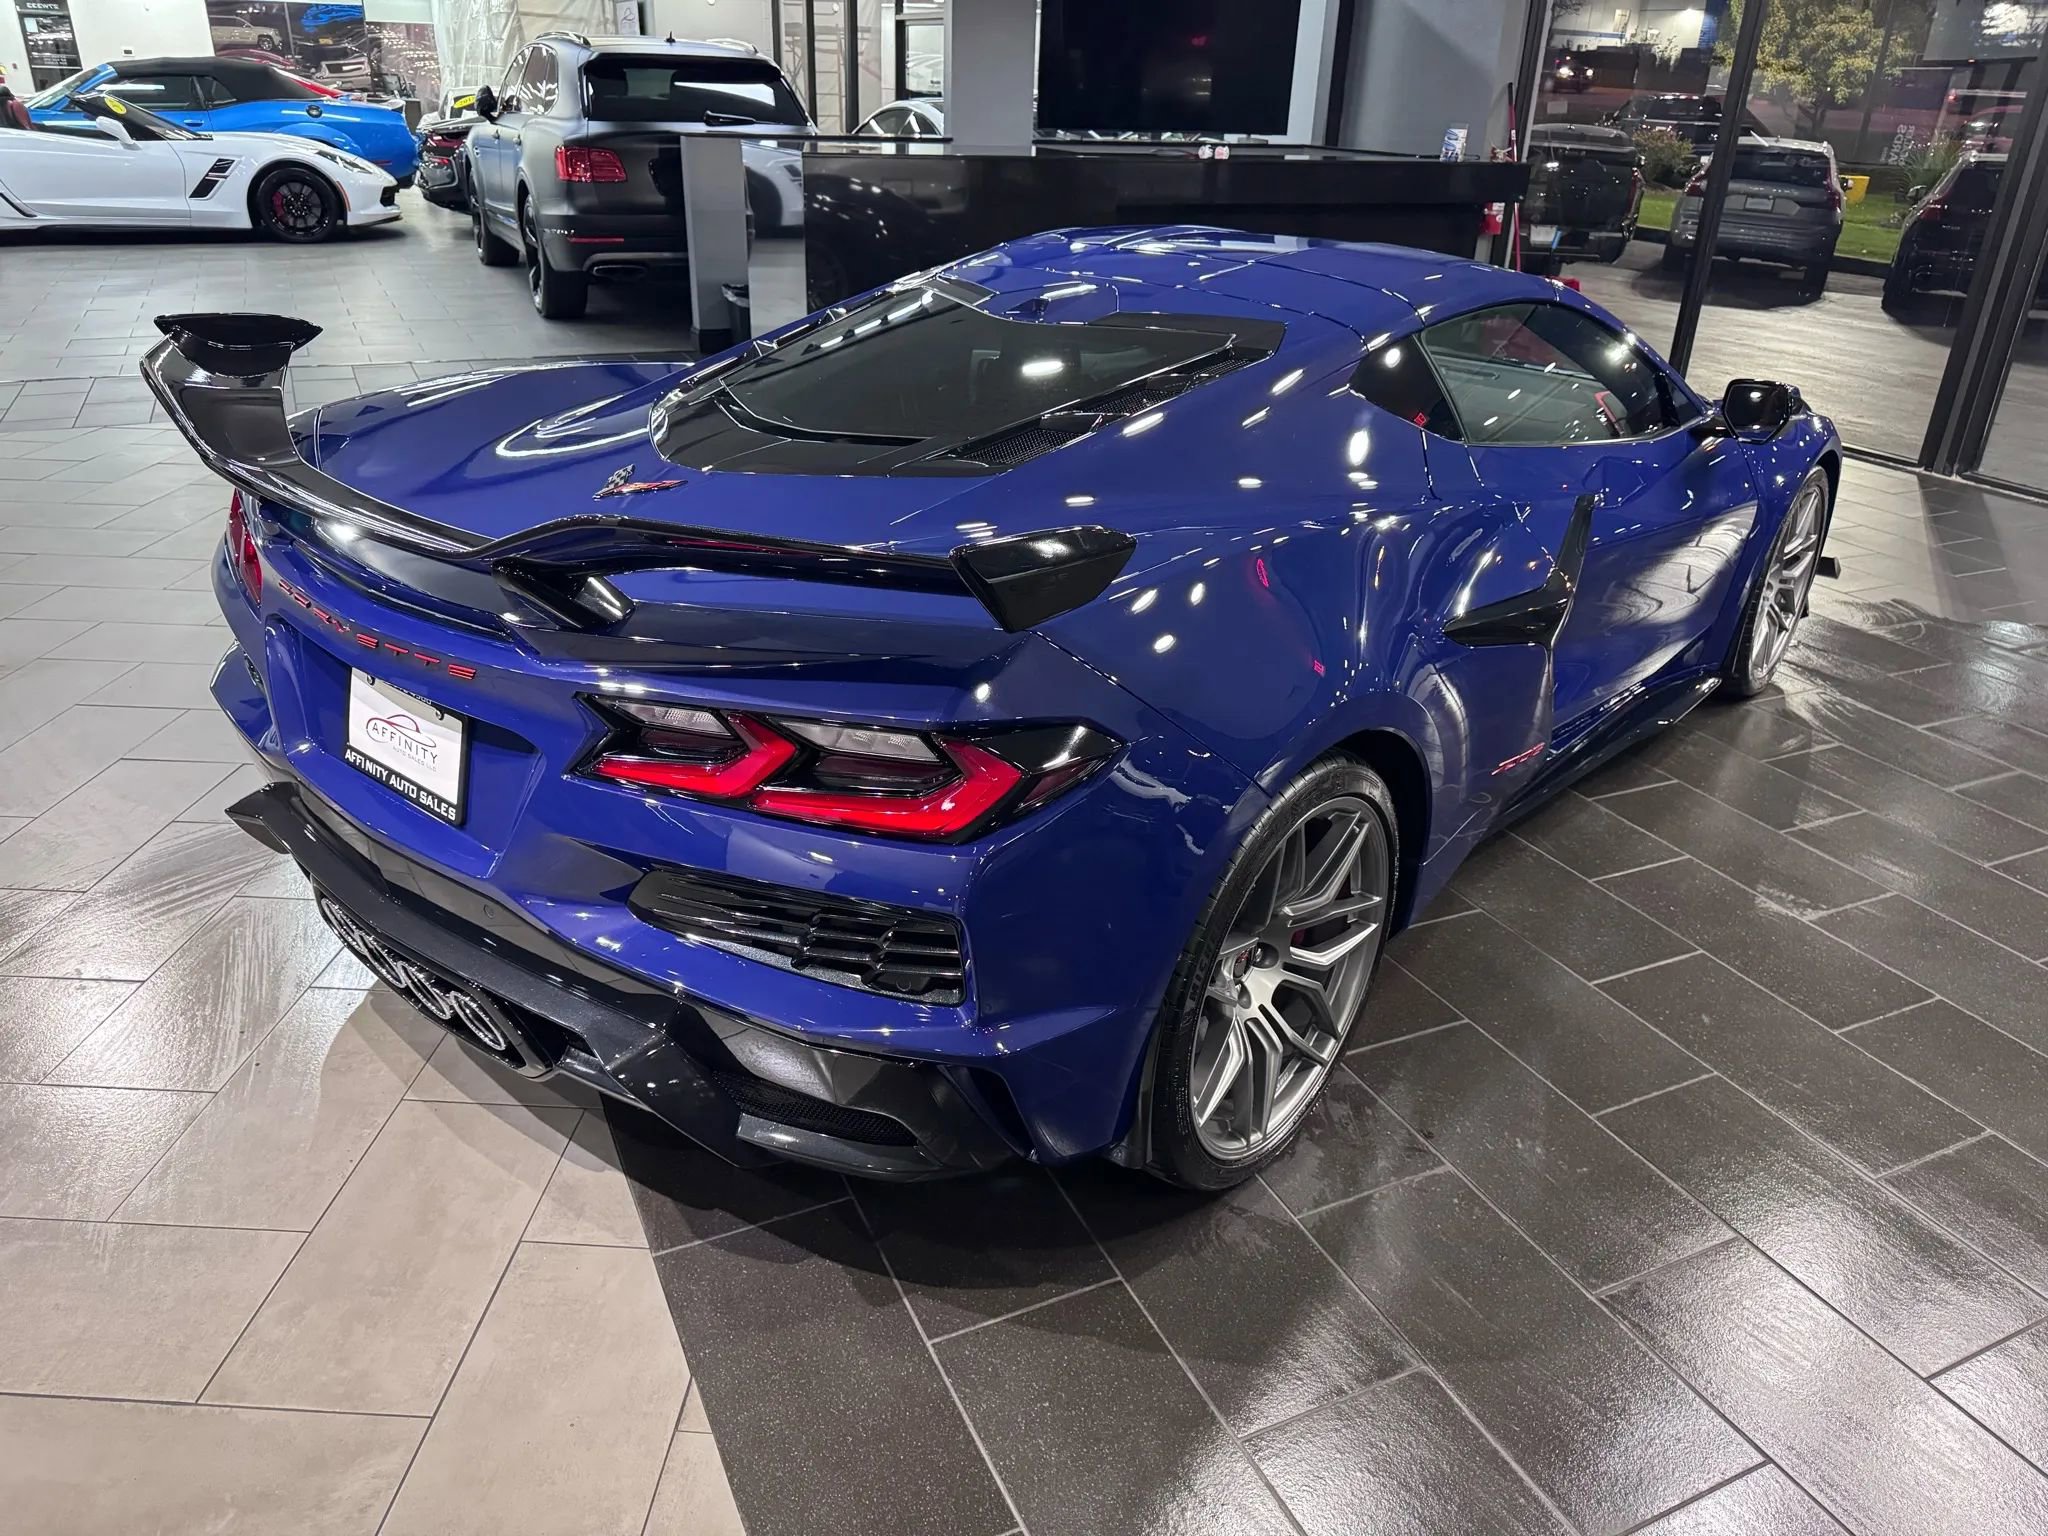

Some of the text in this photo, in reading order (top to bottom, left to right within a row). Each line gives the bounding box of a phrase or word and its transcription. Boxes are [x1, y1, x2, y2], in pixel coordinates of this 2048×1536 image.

[371, 722, 438, 764] AFFINITY
[407, 753, 425, 766] SALES
[345, 748, 456, 821] AFFINITY AUTO SALES
